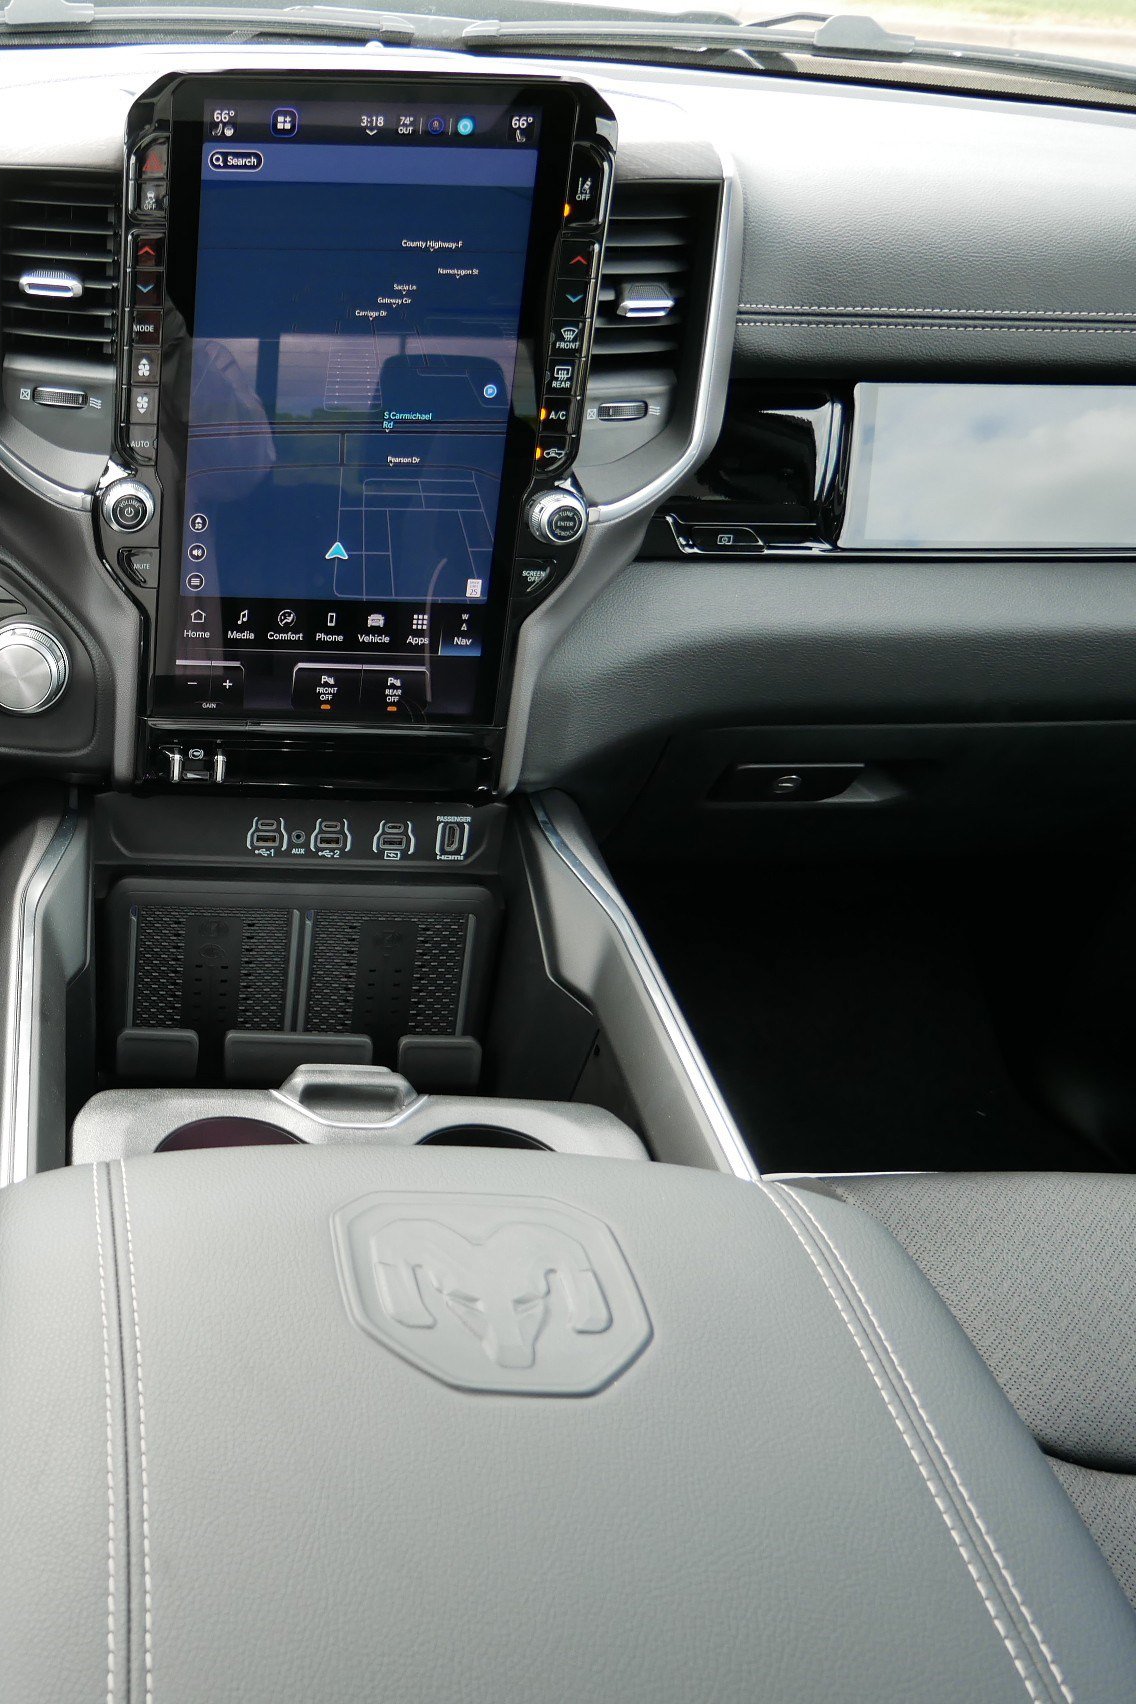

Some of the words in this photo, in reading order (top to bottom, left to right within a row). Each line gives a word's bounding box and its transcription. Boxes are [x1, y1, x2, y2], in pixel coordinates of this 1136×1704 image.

[214, 110, 234, 122] 66°
[400, 116, 413, 125] 74°
[361, 116, 384, 126] 3:18
[511, 116, 533, 129] 66°
[398, 126, 413, 134] OUT
[227, 156, 257, 166] Search
[402, 240, 426, 248] County
[390, 411, 432, 420] Carmichael
[549, 410, 566, 420] A/C
[119, 500, 141, 508] VOLUME
[184, 630, 210, 638] Home
[228, 631, 254, 639] Media
[268, 632, 303, 641] Comfort
[316, 633, 343, 642] Phone
[358, 634, 390, 643] Vehicle
[407, 636, 429, 645] Apps
[454, 637, 472, 645] Nav
[333, 850, 340, 858] 2
